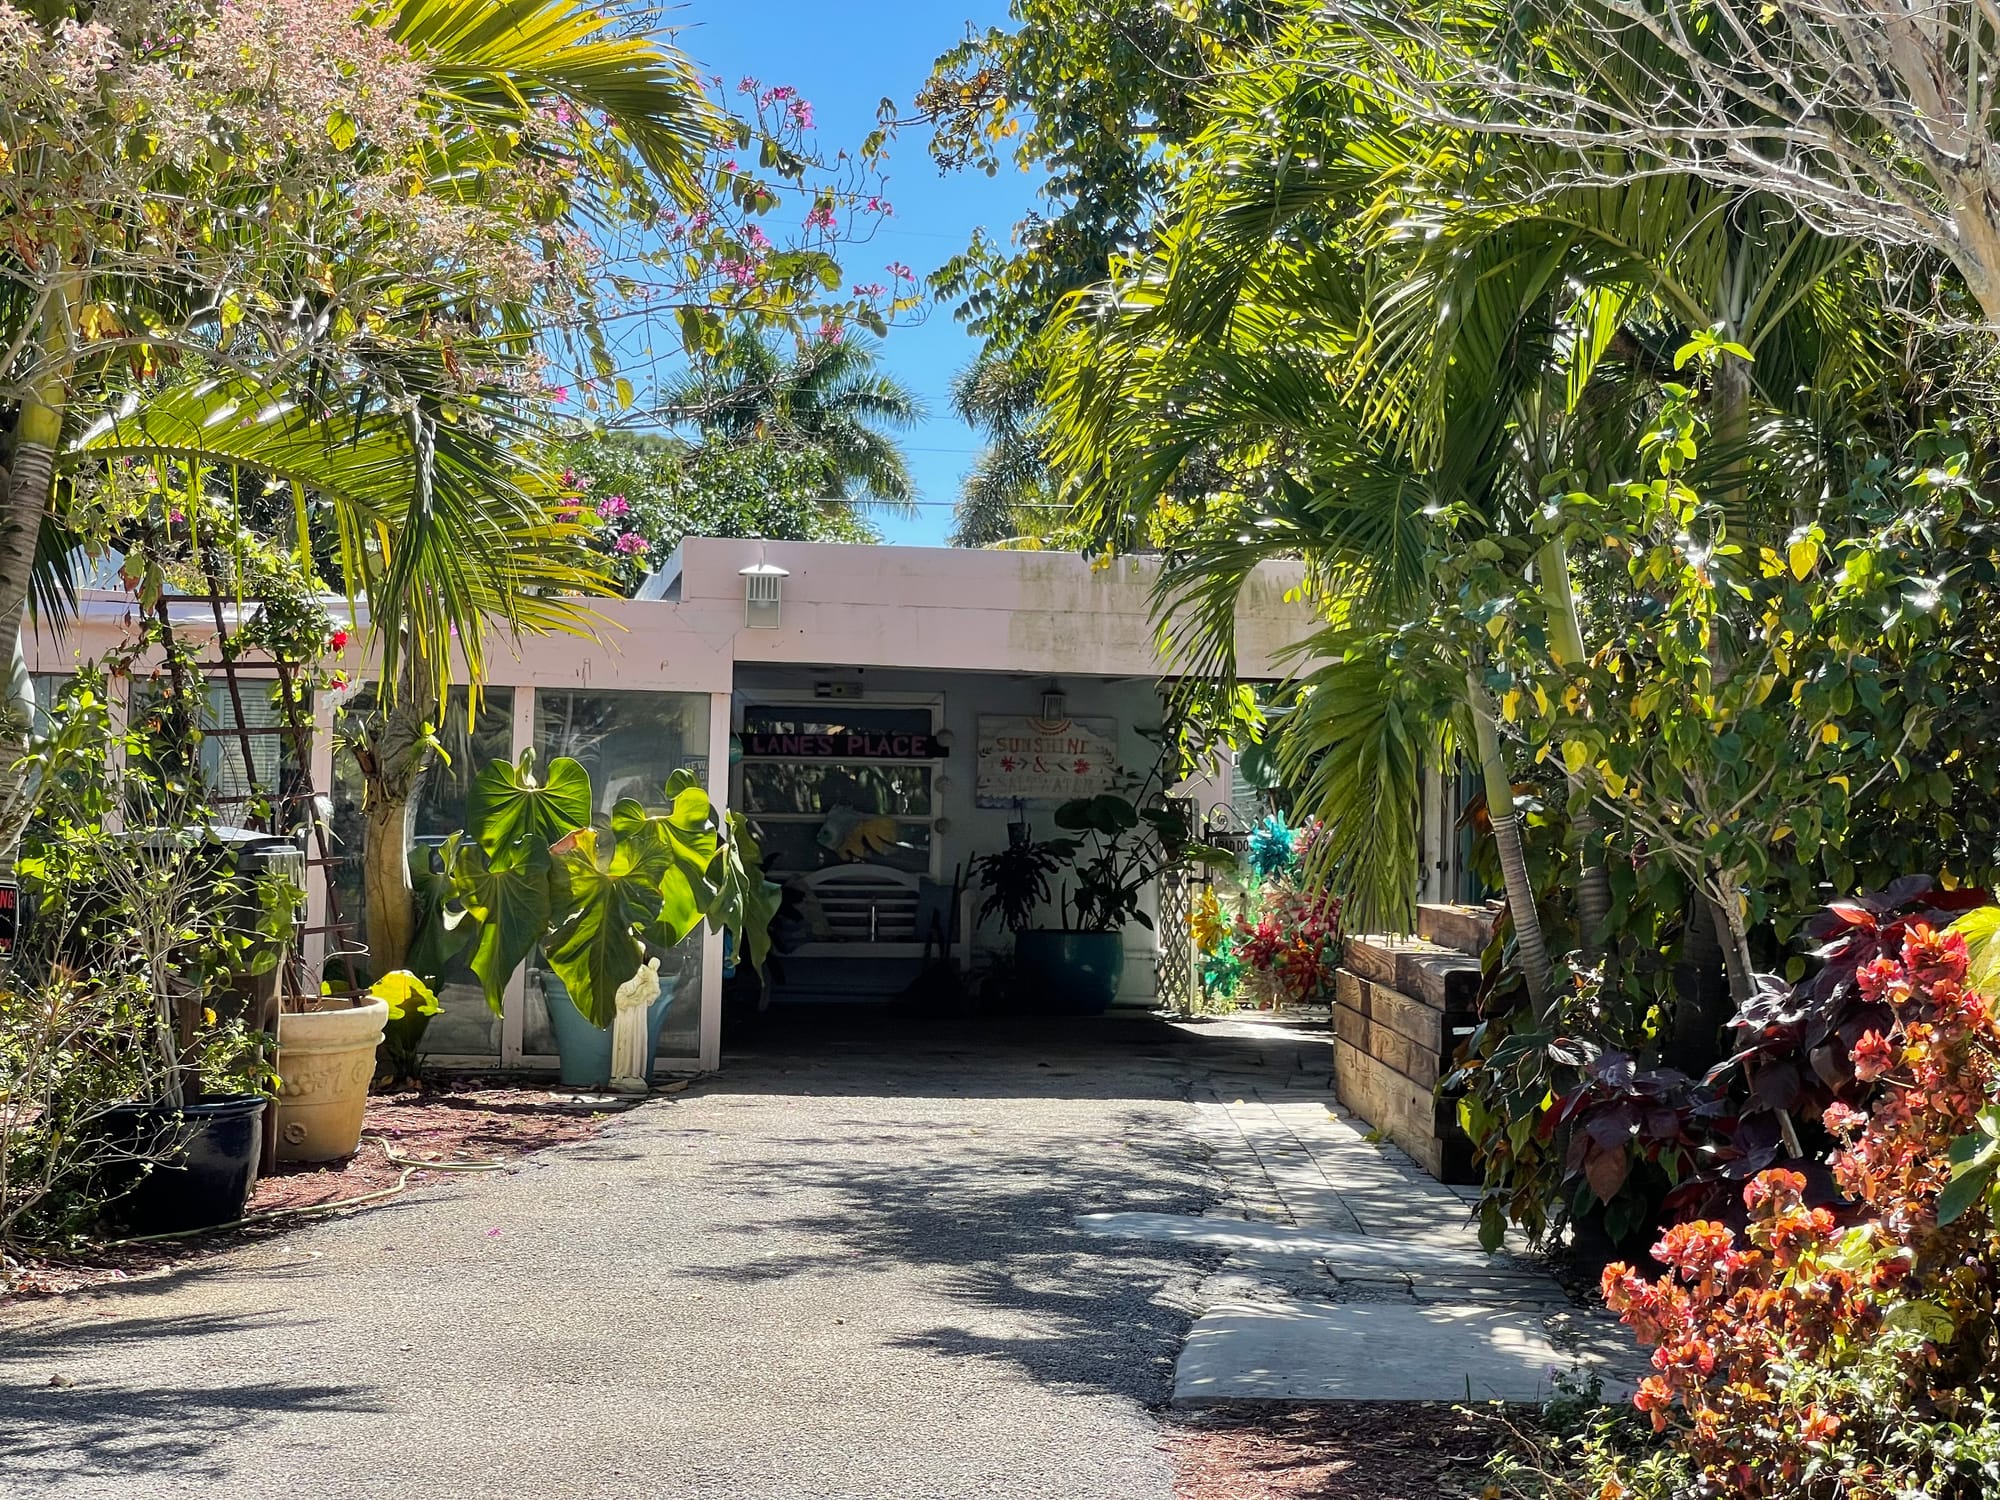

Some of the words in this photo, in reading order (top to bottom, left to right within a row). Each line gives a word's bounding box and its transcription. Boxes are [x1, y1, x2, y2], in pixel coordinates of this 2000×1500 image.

[847, 735, 928, 756] PLACE
[996, 737, 1089, 755] SUNSHINE
[1033, 756, 1050, 773] &
[1237, 840, 1254, 852] DO
